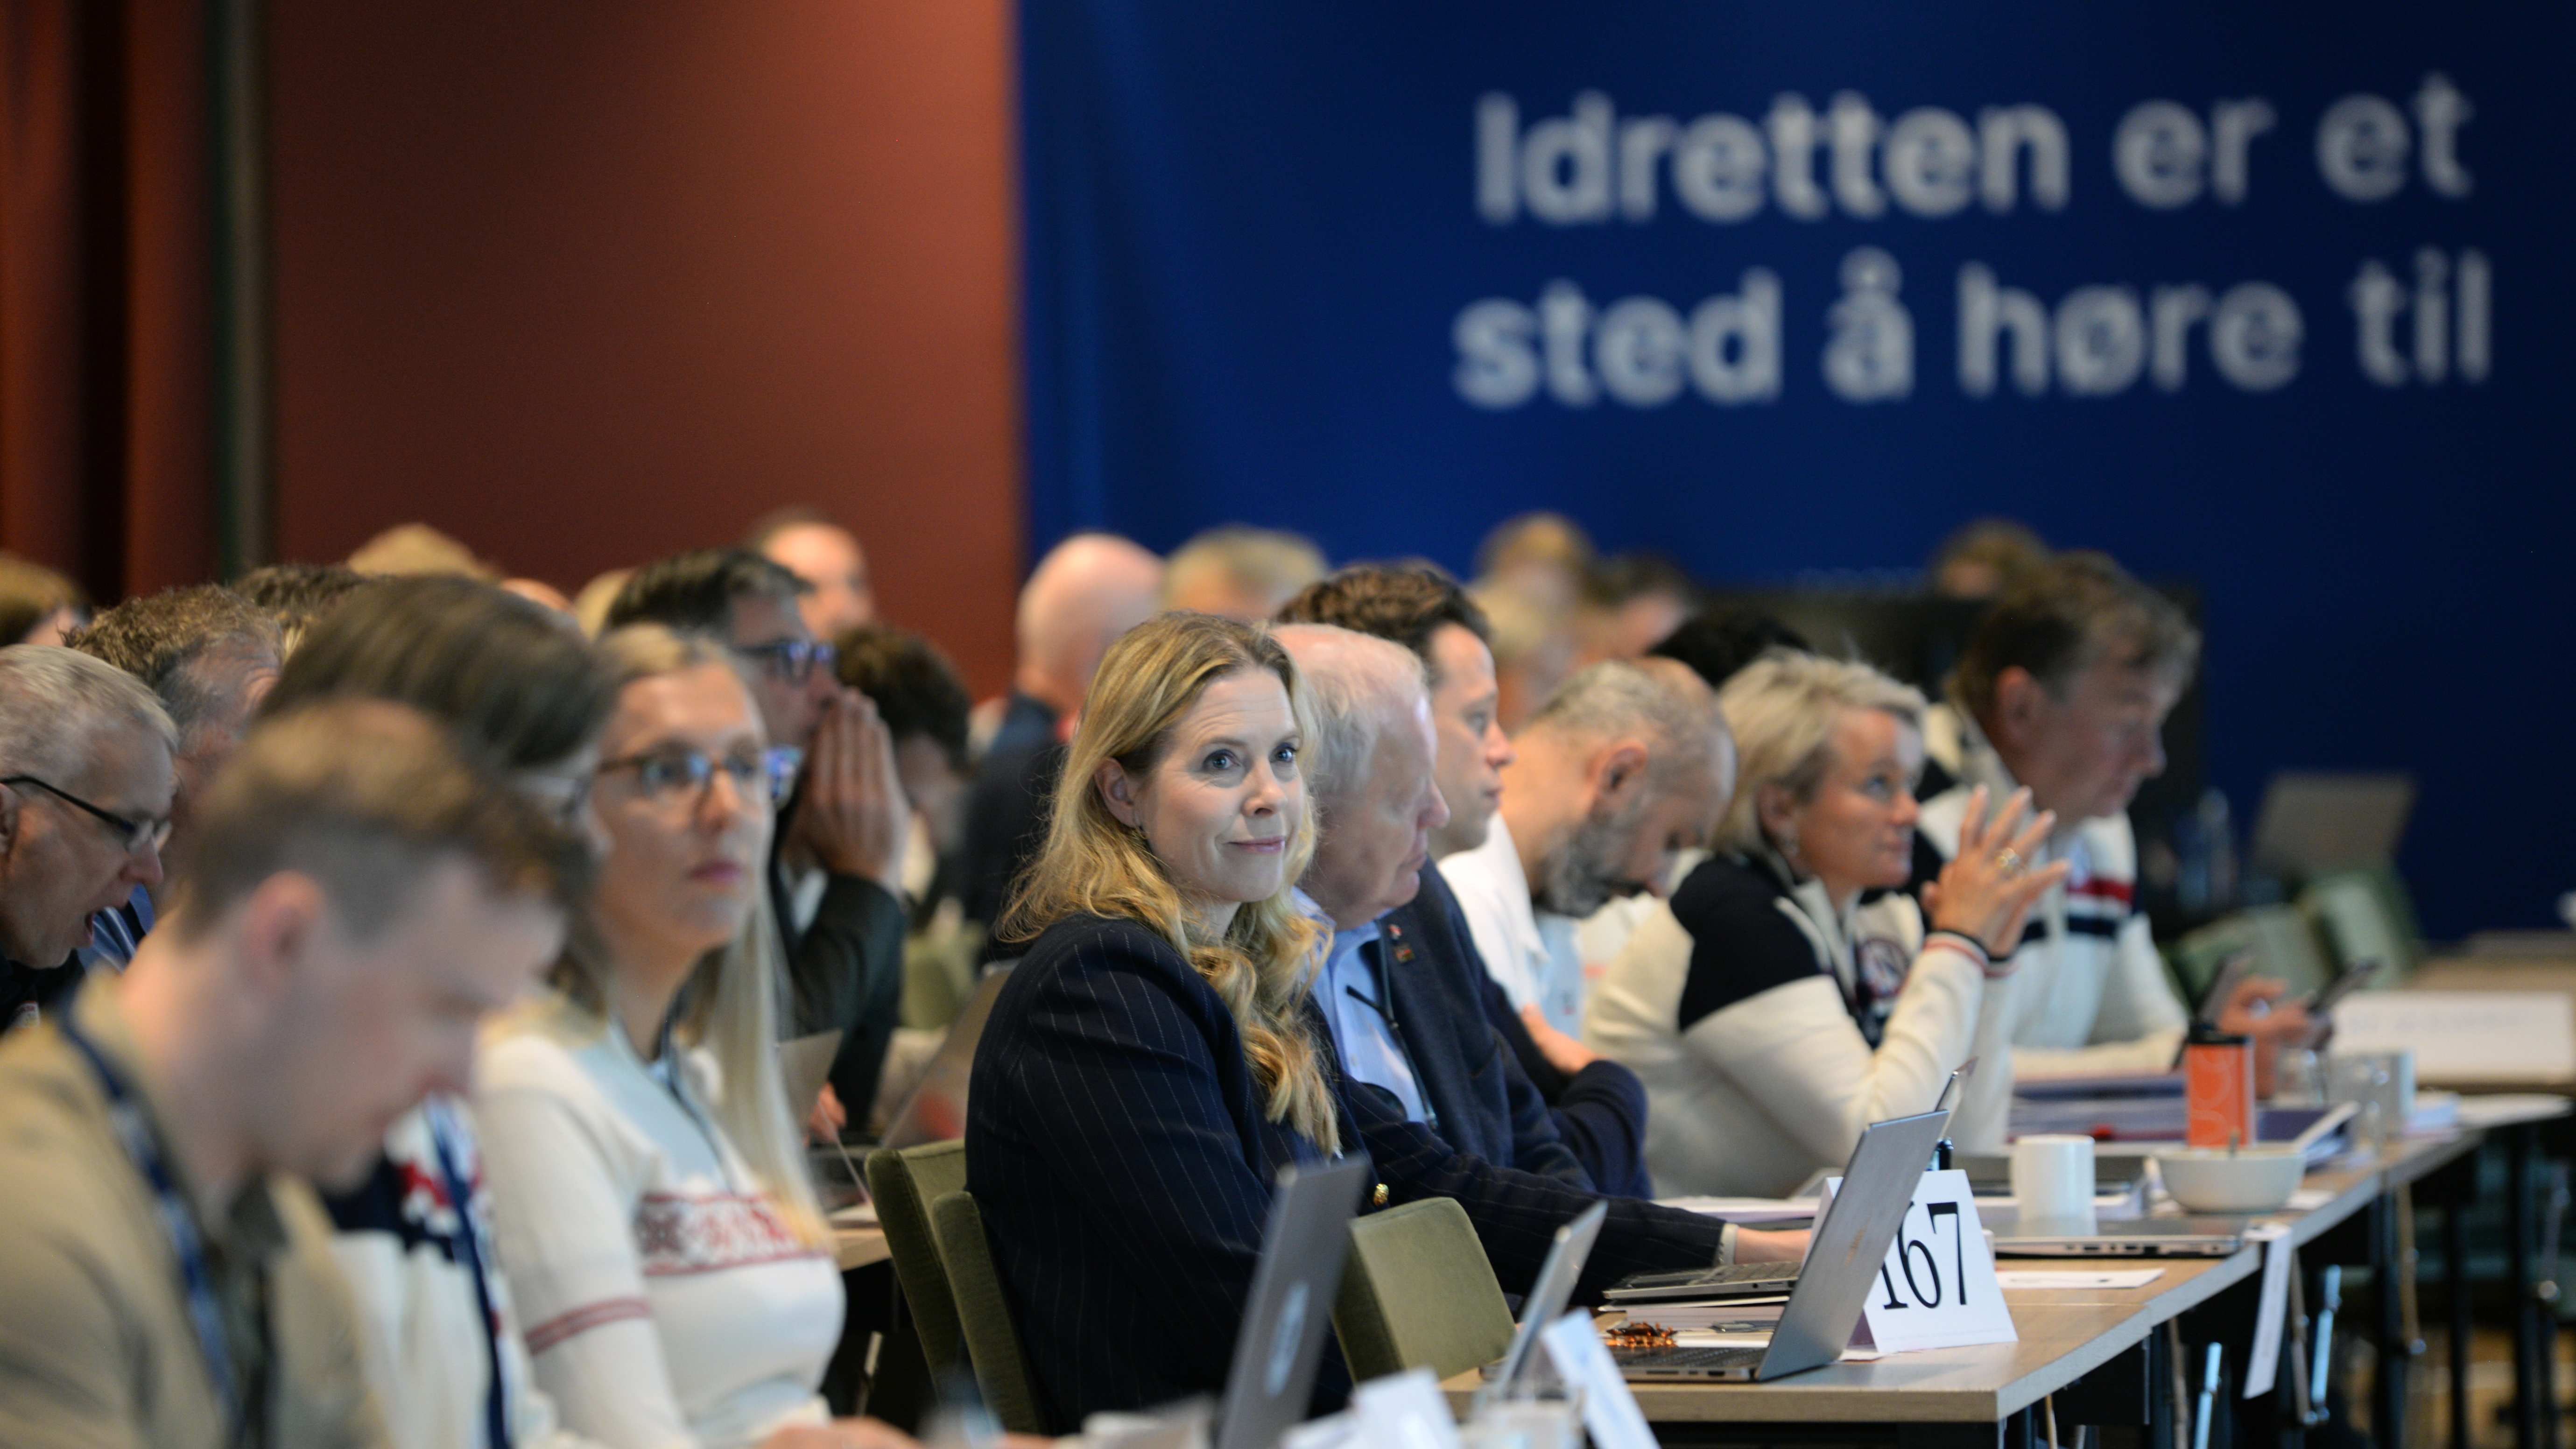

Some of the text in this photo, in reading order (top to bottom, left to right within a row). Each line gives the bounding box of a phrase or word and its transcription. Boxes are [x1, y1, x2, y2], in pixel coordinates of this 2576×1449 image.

[1475, 75, 2470, 225] Idretten er et
[1452, 246, 2490, 410] sted å høre til
[1880, 1201, 1967, 1309] 167
